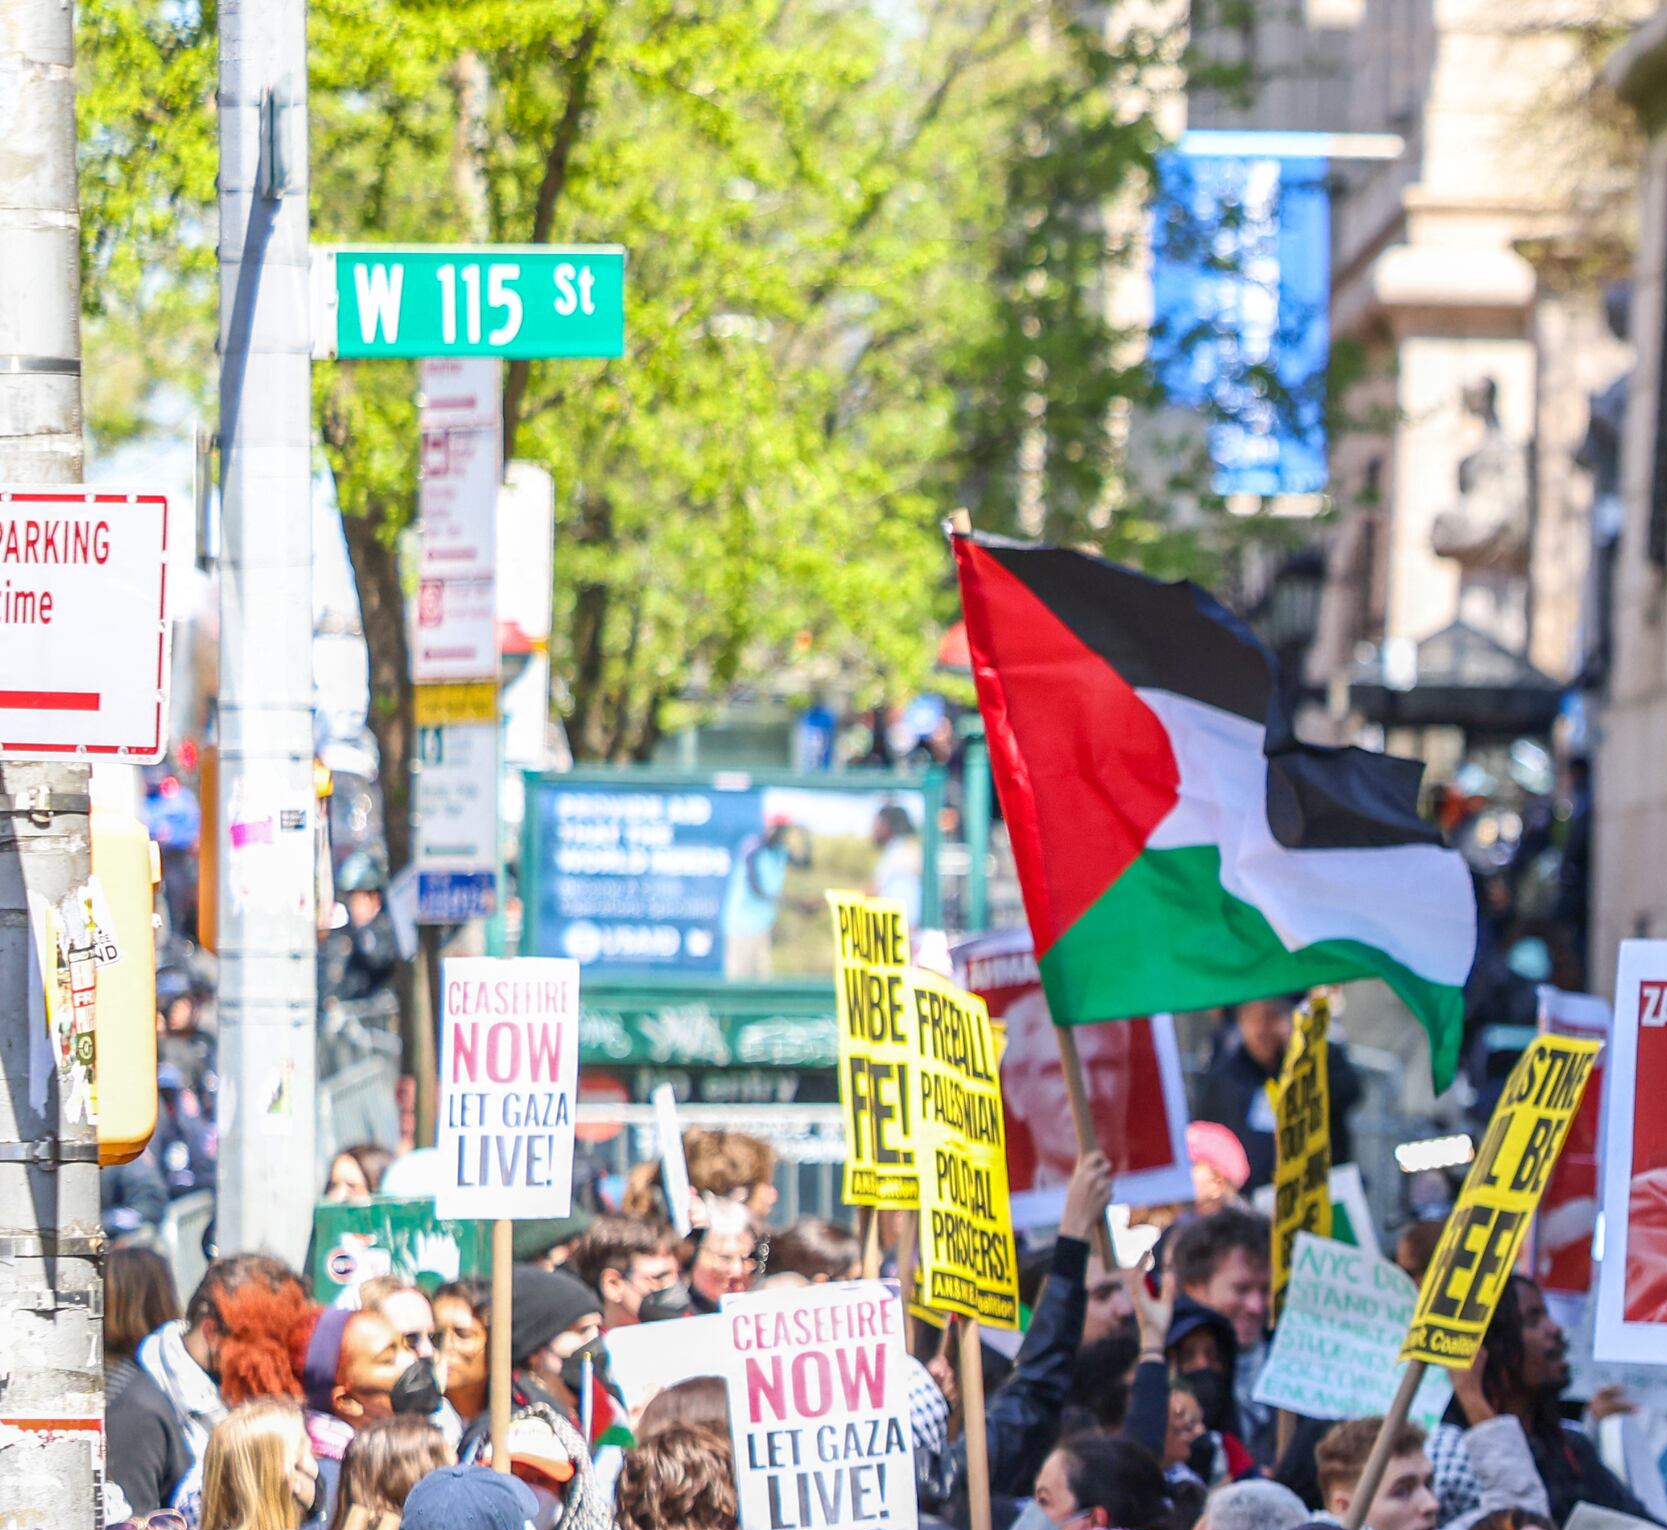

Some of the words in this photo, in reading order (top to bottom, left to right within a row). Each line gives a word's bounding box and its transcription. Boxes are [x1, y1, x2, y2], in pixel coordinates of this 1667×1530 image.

[354, 262, 404, 344] W
[436, 263, 524, 346] 115
[554, 262, 595, 316] St
[0, 520, 110, 564] ARKING
[0, 580, 53, 624] ime
[449, 981, 568, 1016] CEASEFIRE
[452, 1022, 563, 1084] NOW
[449, 1092, 491, 1128] LET
[502, 1092, 569, 1128] GAZA
[457, 1134, 554, 1187] LIVE!
[732, 1299, 897, 1351] CEASEFIRE
[745, 1343, 886, 1423] NOW
[747, 1429, 803, 1470] LET
[816, 1417, 906, 1463] GAZA
